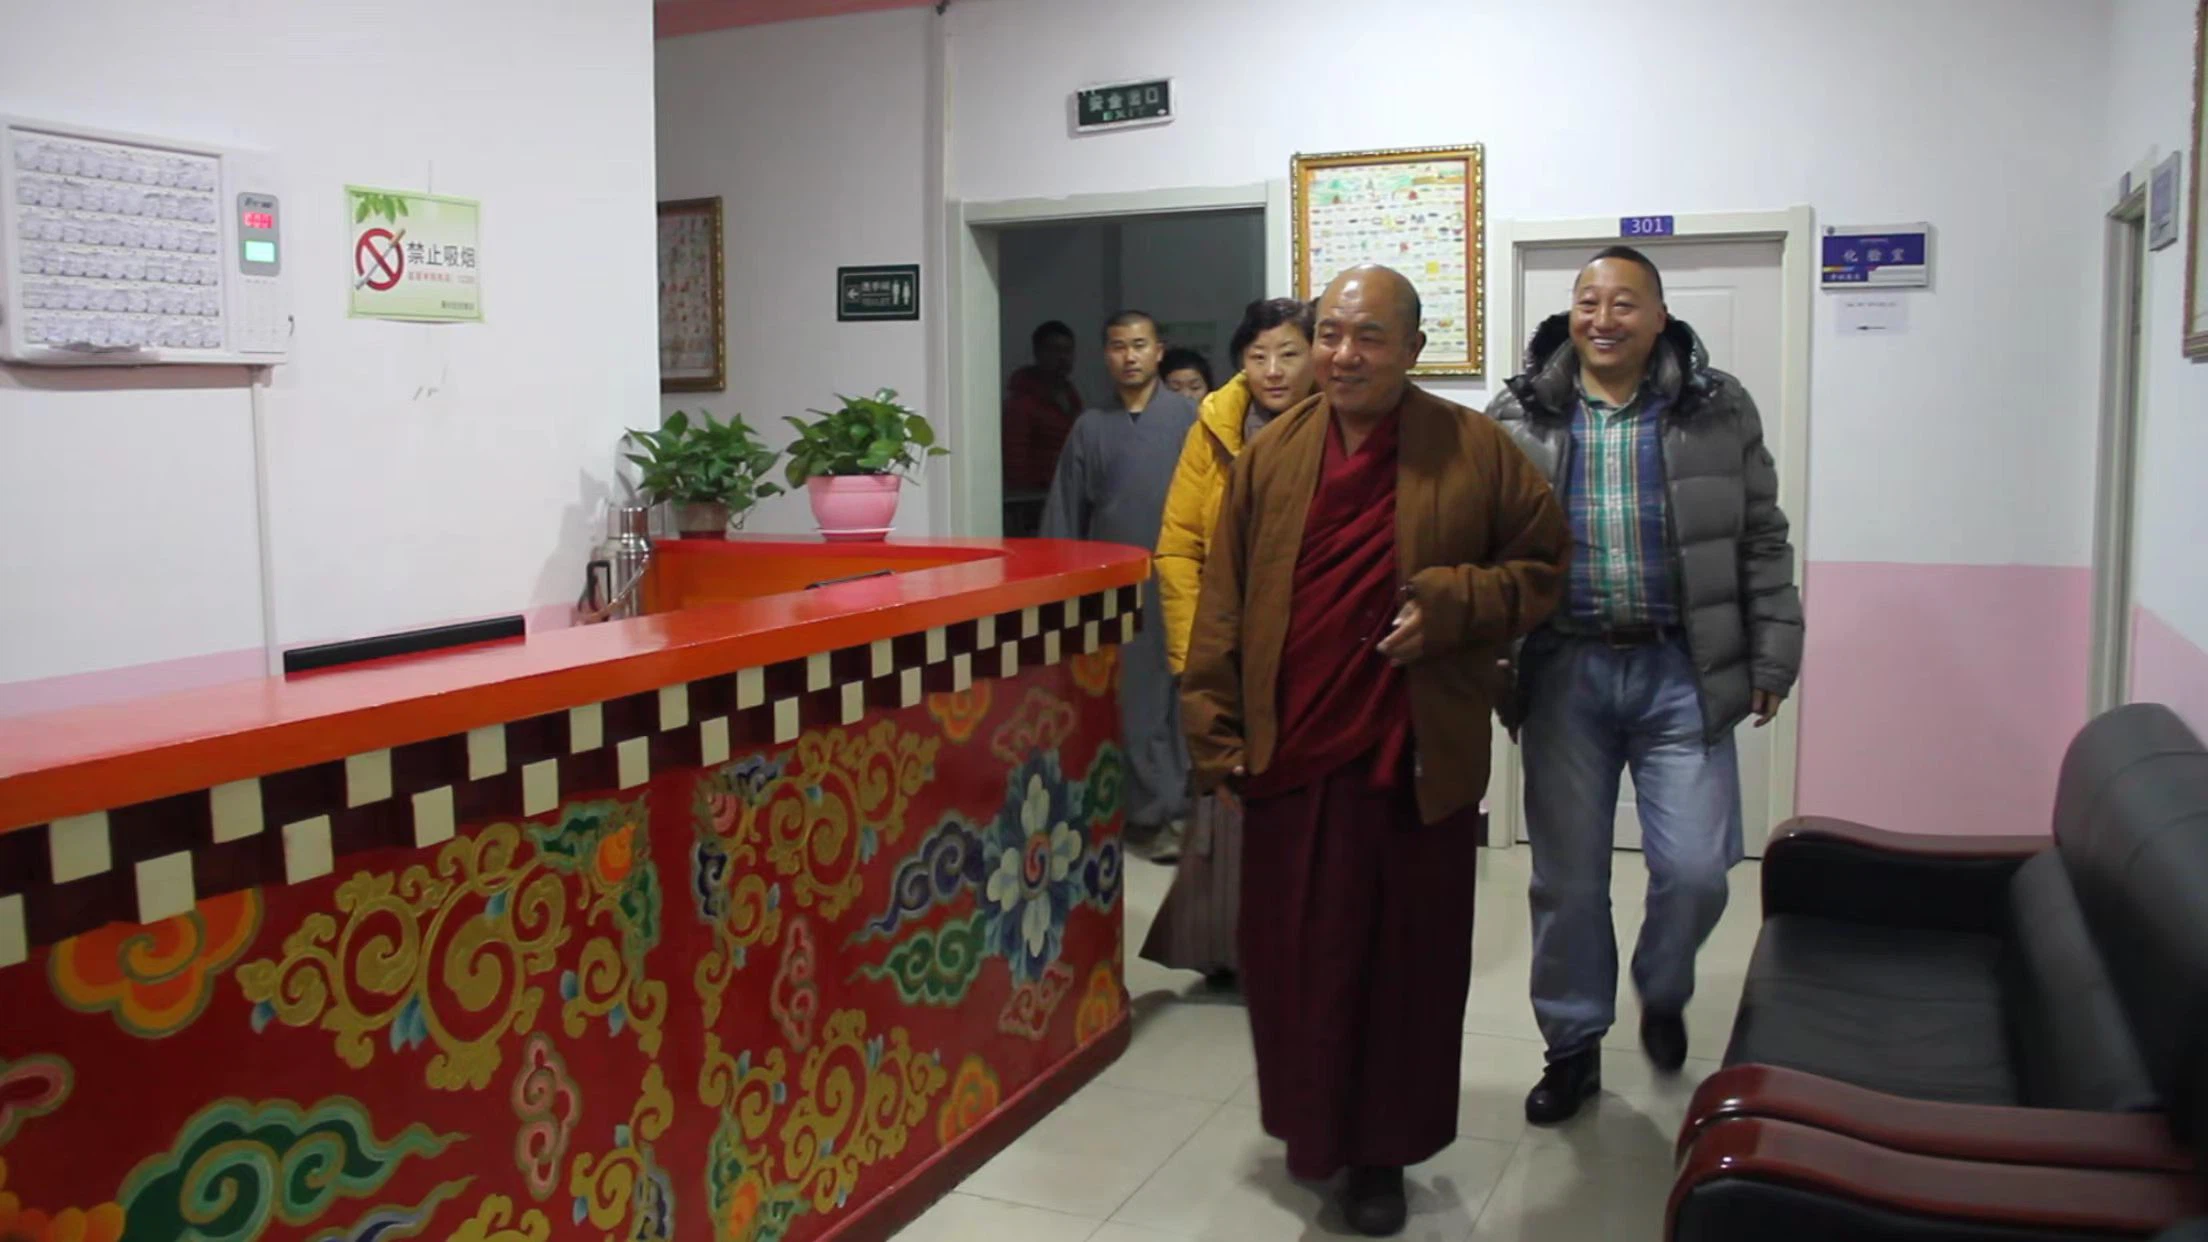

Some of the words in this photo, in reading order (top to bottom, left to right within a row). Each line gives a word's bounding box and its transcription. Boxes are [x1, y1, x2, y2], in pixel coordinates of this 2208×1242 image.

[1631, 218, 1664, 233] 301
[407, 242, 475, 268] 禁止吸烟
